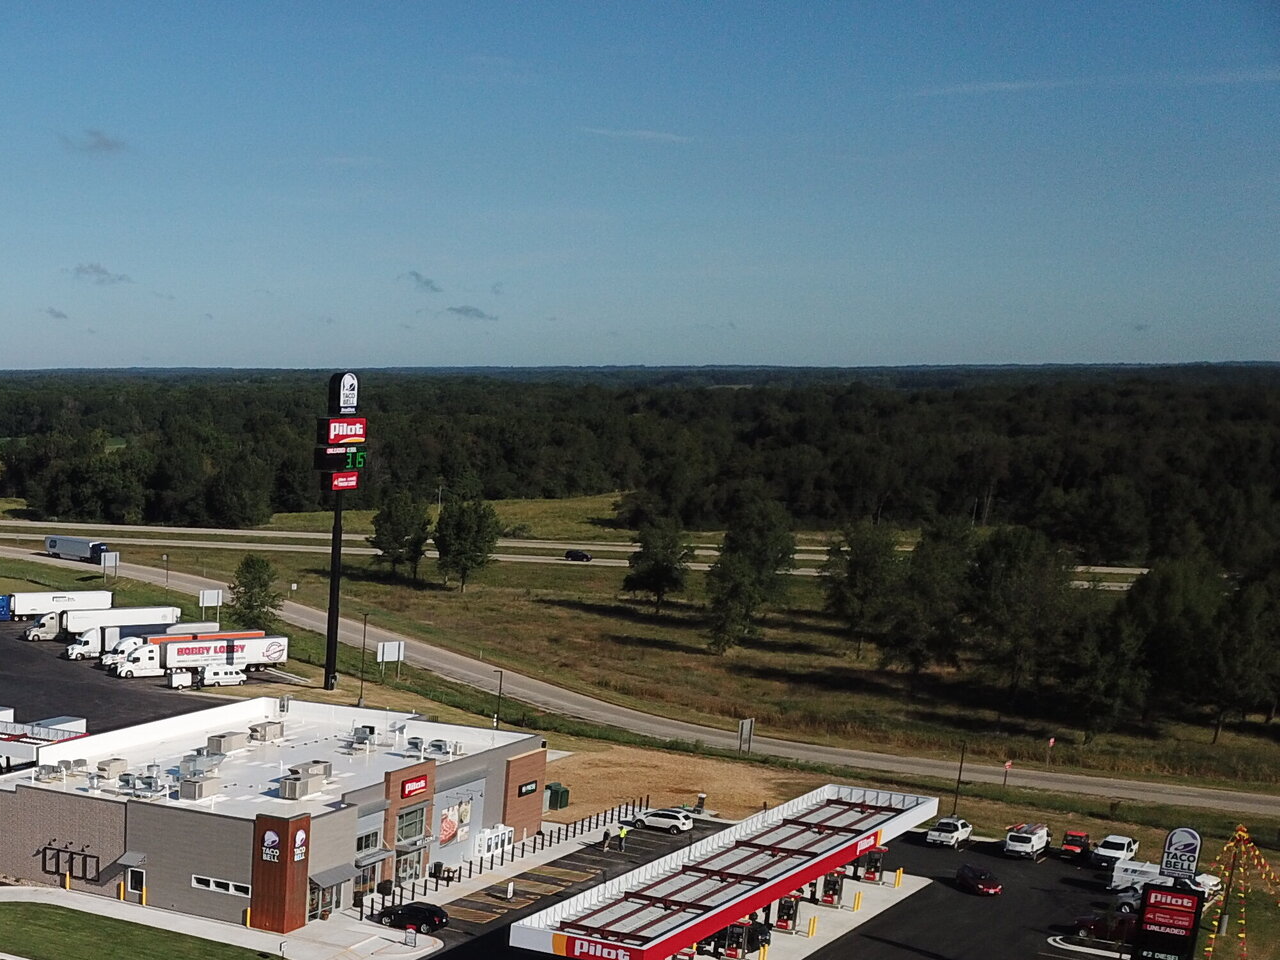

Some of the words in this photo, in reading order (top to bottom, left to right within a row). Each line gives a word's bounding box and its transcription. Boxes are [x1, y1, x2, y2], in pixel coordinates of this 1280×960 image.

[177, 646, 211, 656] HOBBY
[262, 846, 280, 856] TACO
[294, 846, 306, 854] TACO
[262, 853, 279, 863] BELL
[1165, 851, 1196, 863] TACO
[1165, 860, 1194, 872] BELL
[1146, 924, 1186, 936] UNLEADED
[1142, 950, 1153, 958] #2
